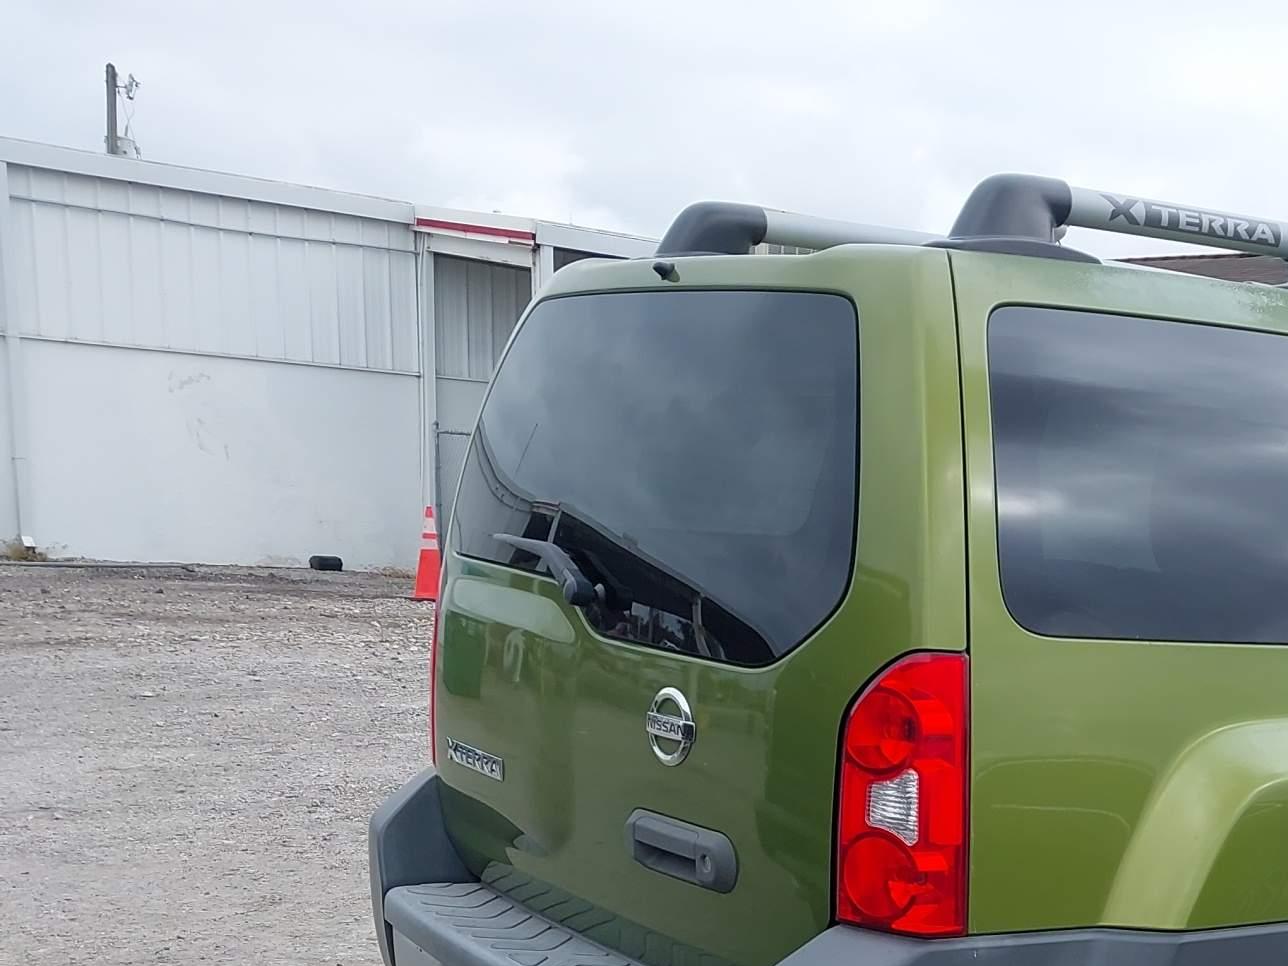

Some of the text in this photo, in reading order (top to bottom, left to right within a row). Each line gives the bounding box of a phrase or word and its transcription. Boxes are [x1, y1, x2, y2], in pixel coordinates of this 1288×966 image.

[1099, 192, 1277, 245] XTERRA
[647, 715, 688, 738] NISSAN
[447, 736, 502, 779] XTERRA
